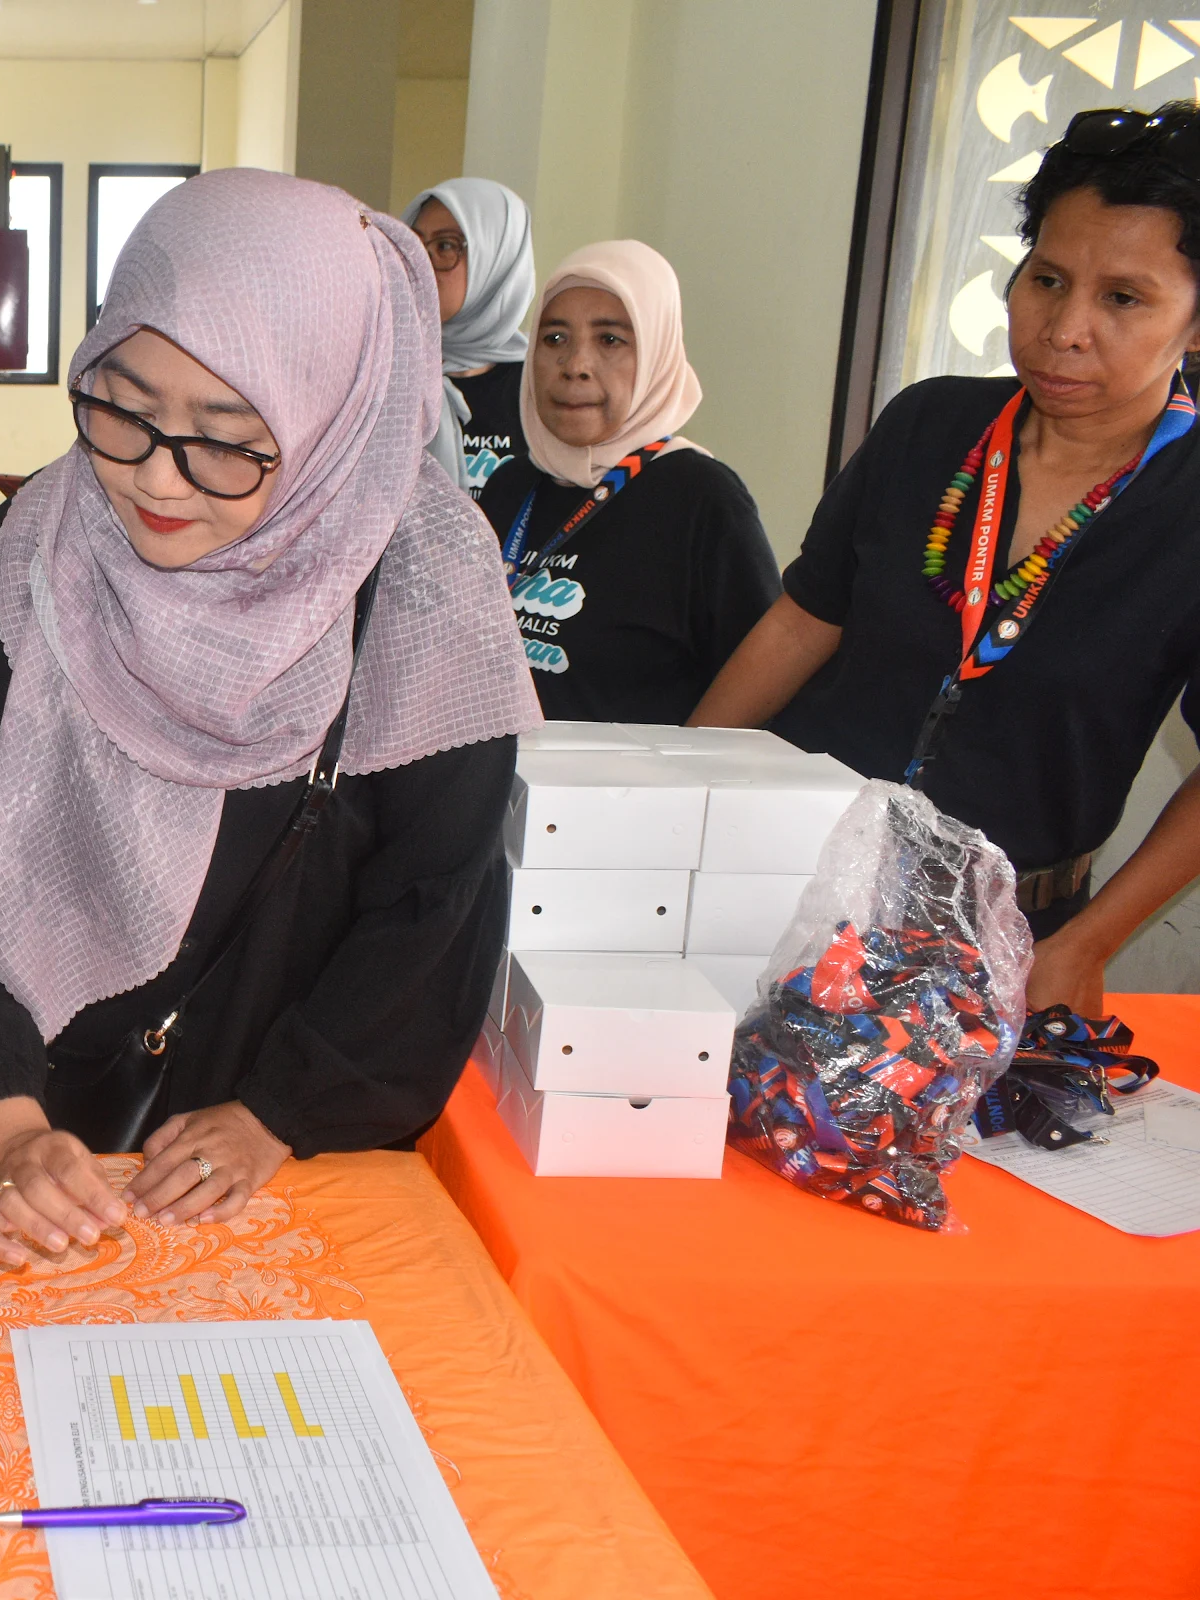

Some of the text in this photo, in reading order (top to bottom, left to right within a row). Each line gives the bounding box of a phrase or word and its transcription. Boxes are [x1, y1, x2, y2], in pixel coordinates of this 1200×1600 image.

[463, 434, 511, 449] MKM
[563, 499, 596, 533] UMKM
[971, 473, 999, 582] UMKM PONTIR
[507, 526, 525, 560] UMKM
